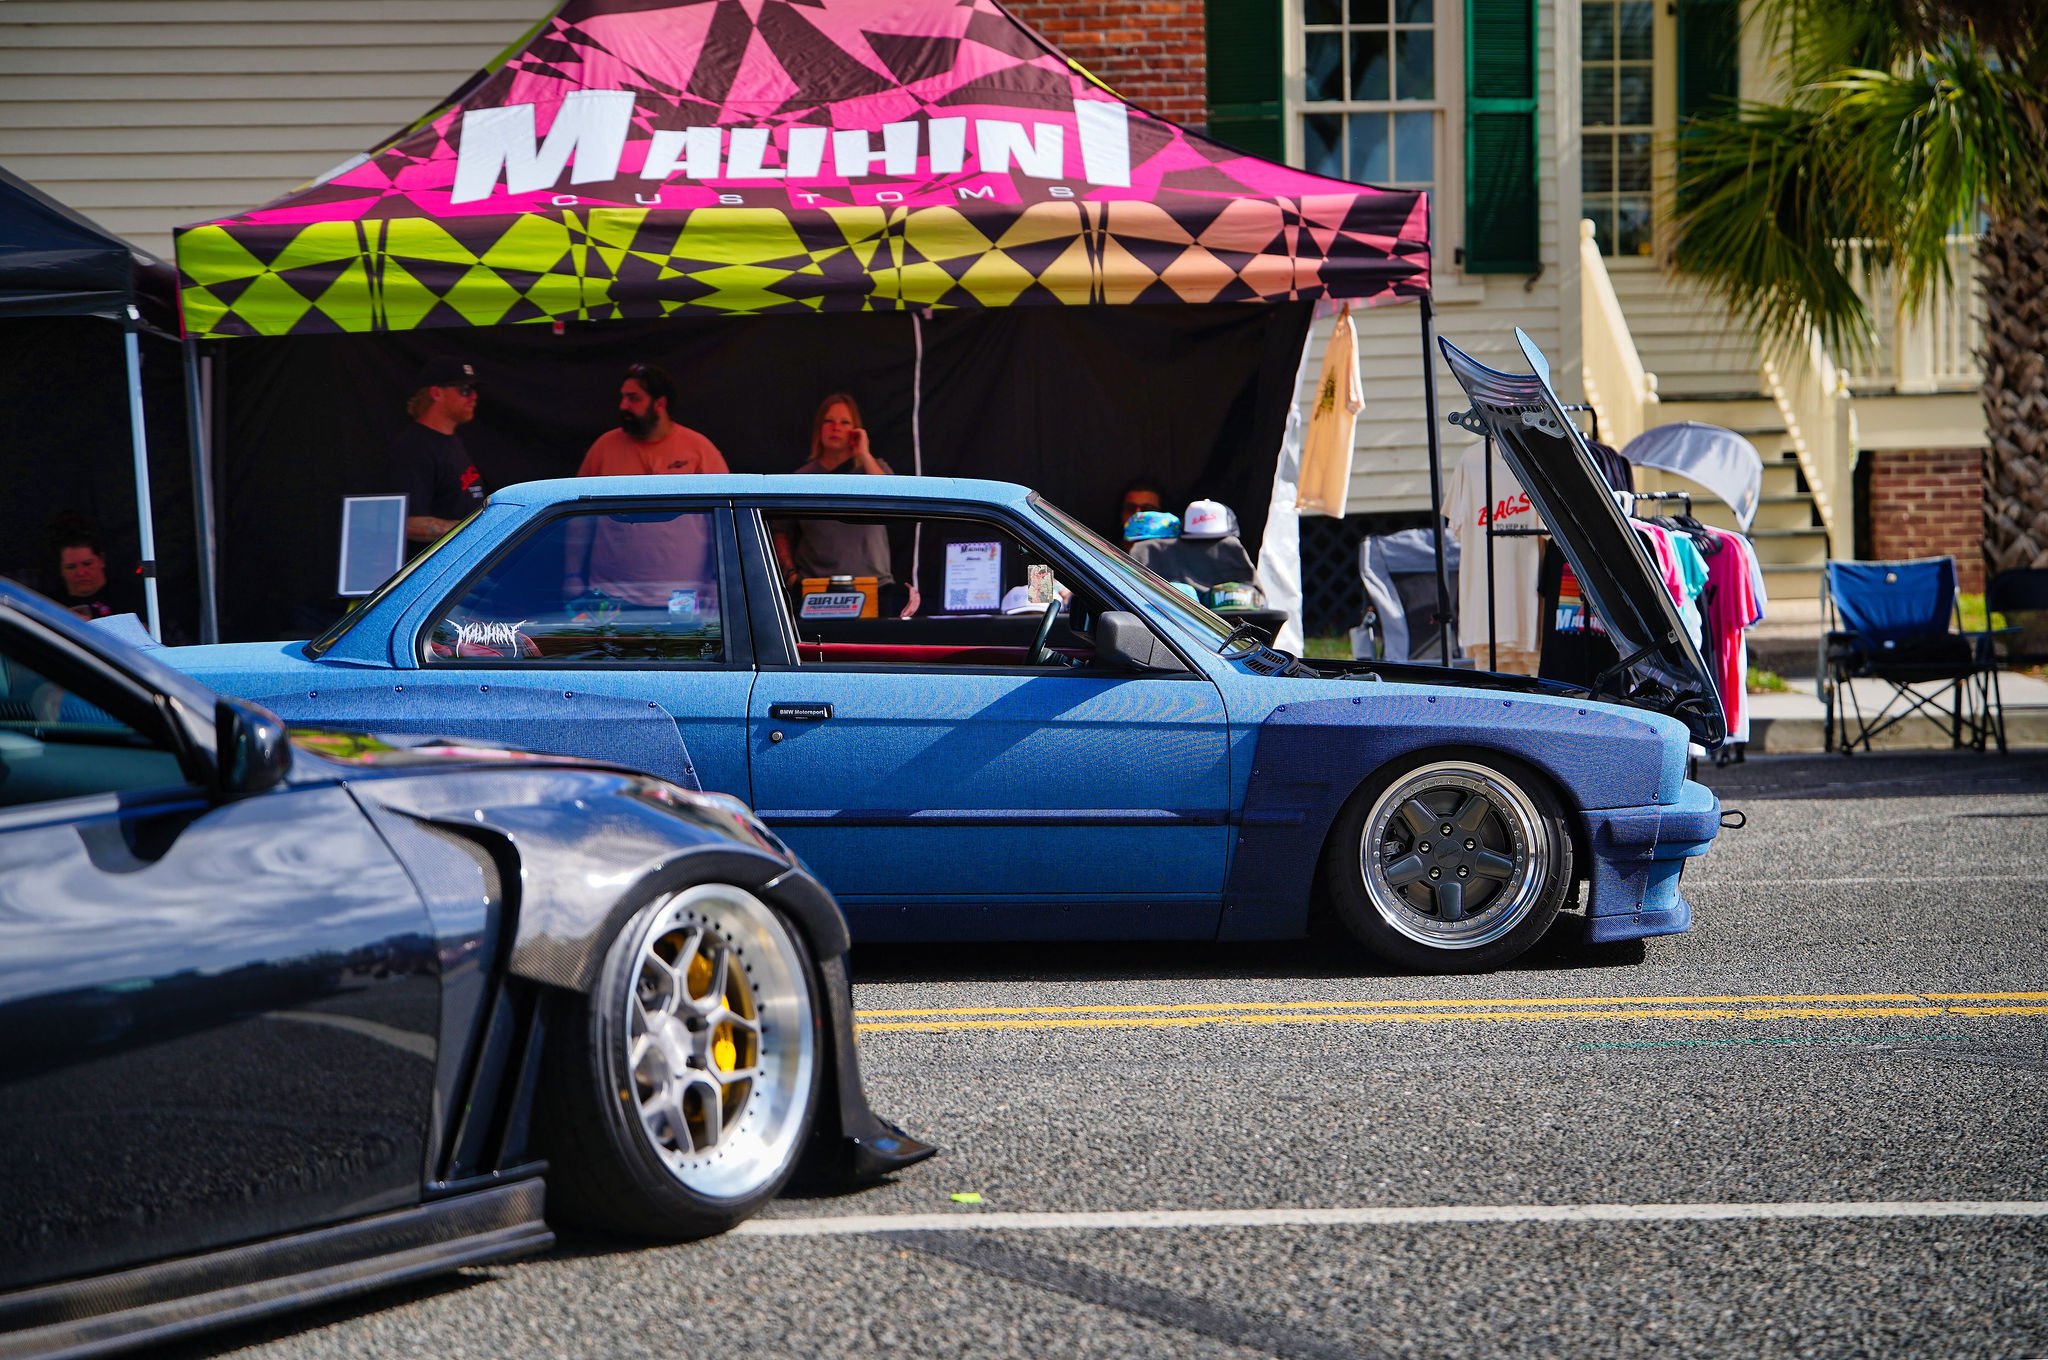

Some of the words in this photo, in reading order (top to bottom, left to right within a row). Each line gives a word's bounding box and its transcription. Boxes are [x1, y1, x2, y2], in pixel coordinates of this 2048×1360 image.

[450, 89, 1131, 204] MALIHINI
[551, 186, 1075, 206] CUSTOMS
[833, 596, 861, 604] LIFT
